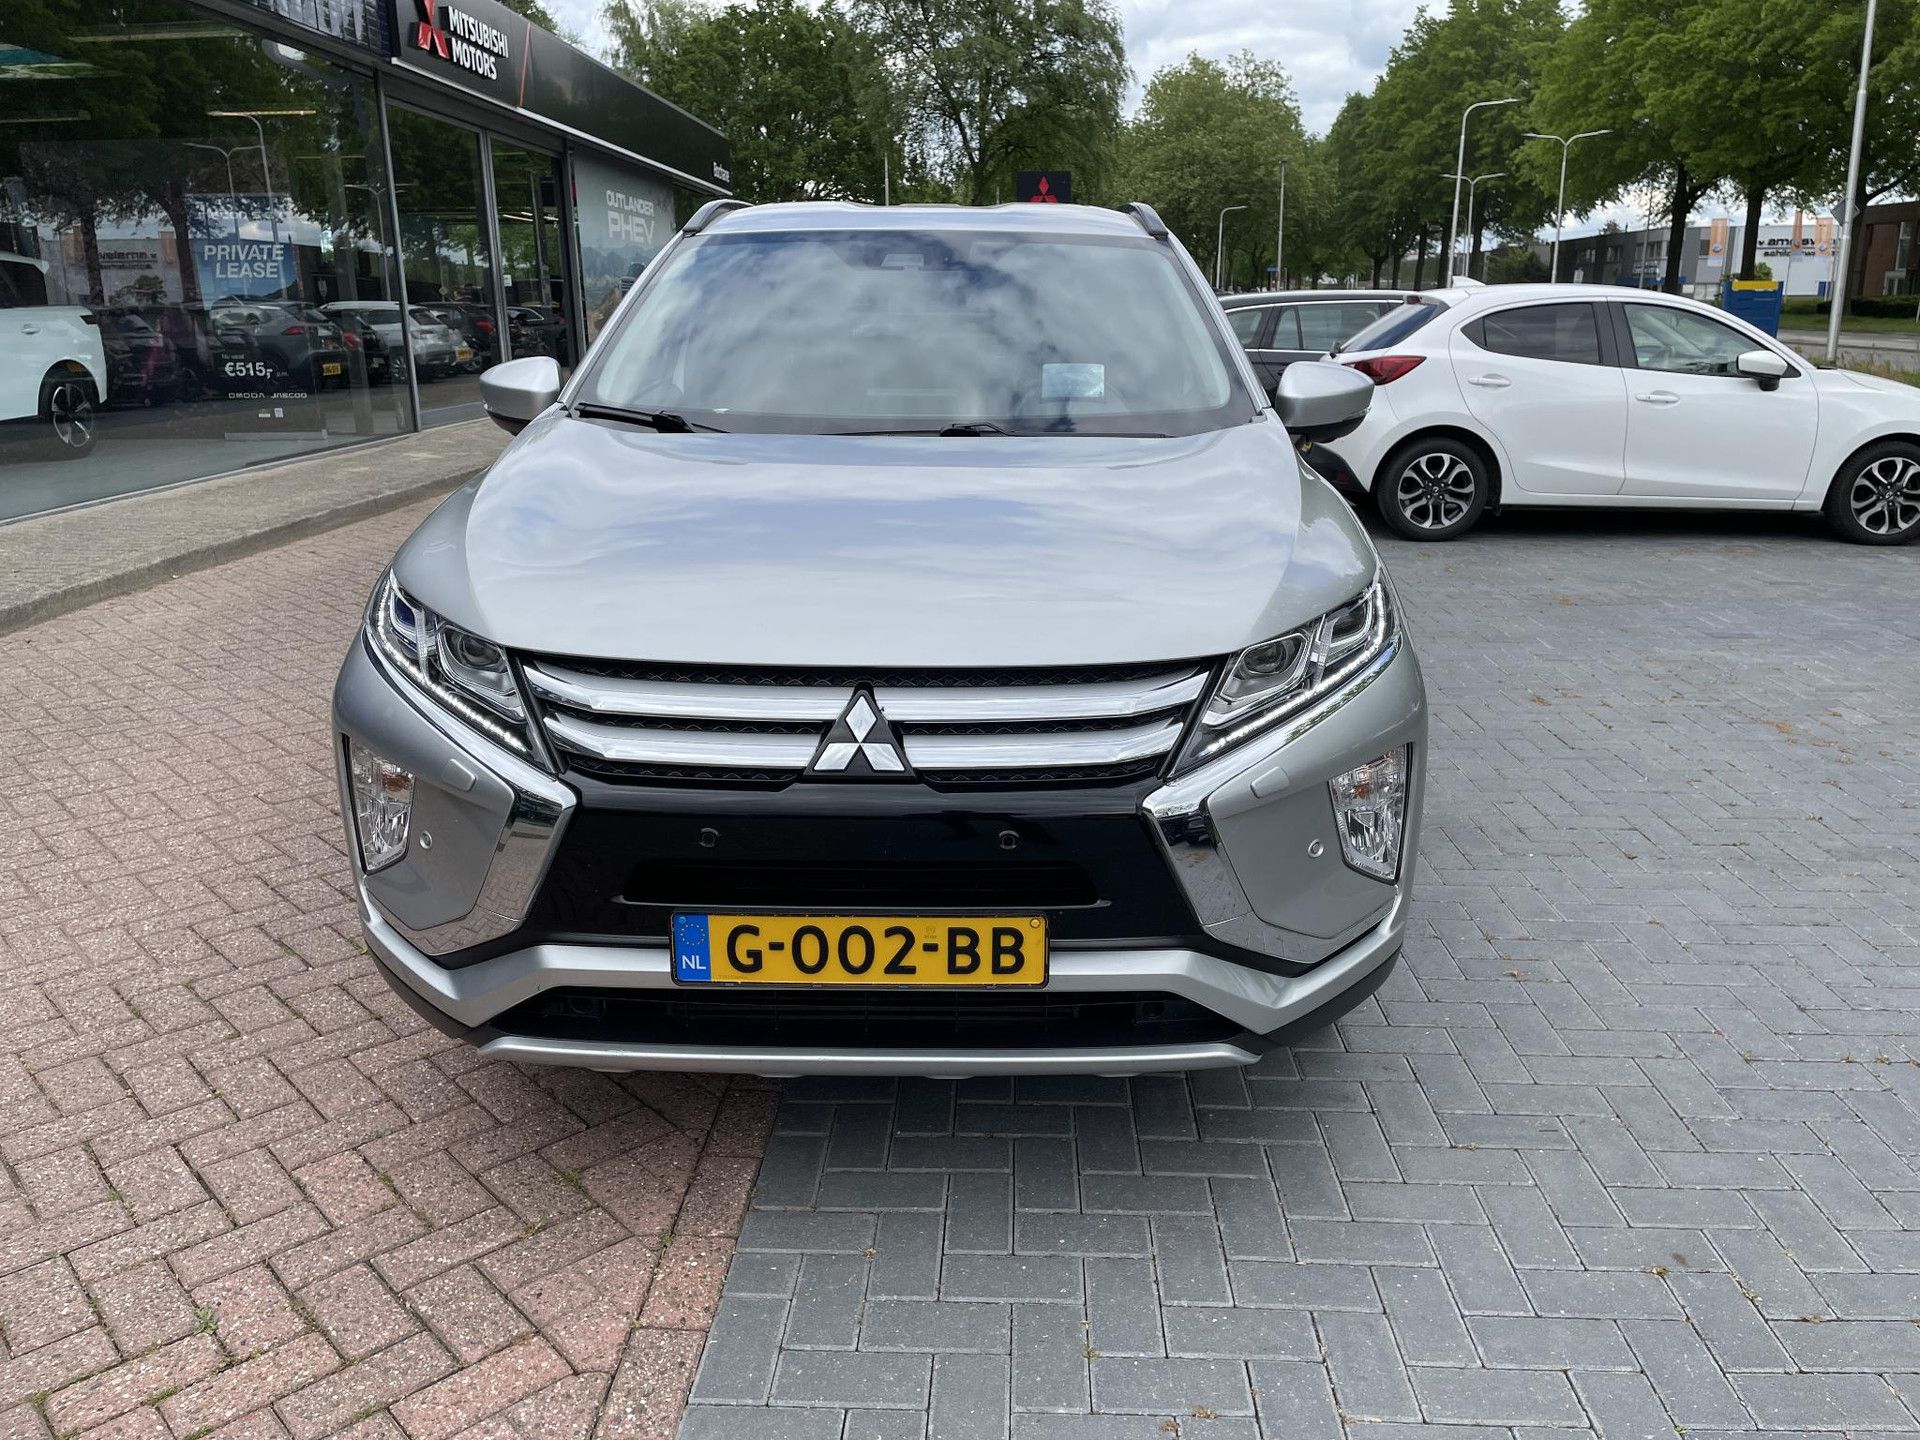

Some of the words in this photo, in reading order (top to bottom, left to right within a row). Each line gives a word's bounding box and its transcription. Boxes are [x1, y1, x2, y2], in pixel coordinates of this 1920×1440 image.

[448, 5, 509, 58] MITSUBISHI
[451, 37, 497, 80] MOTORS
[606, 190, 655, 217] OUTLANDER
[607, 210, 655, 245] PHEV
[204, 244, 284, 261] PRIVATE
[215, 262, 278, 279] LEASE
[224, 361, 273, 380] €515,-
[681, 954, 707, 970] NL
[725, 924, 1026, 975] G-002-BB
